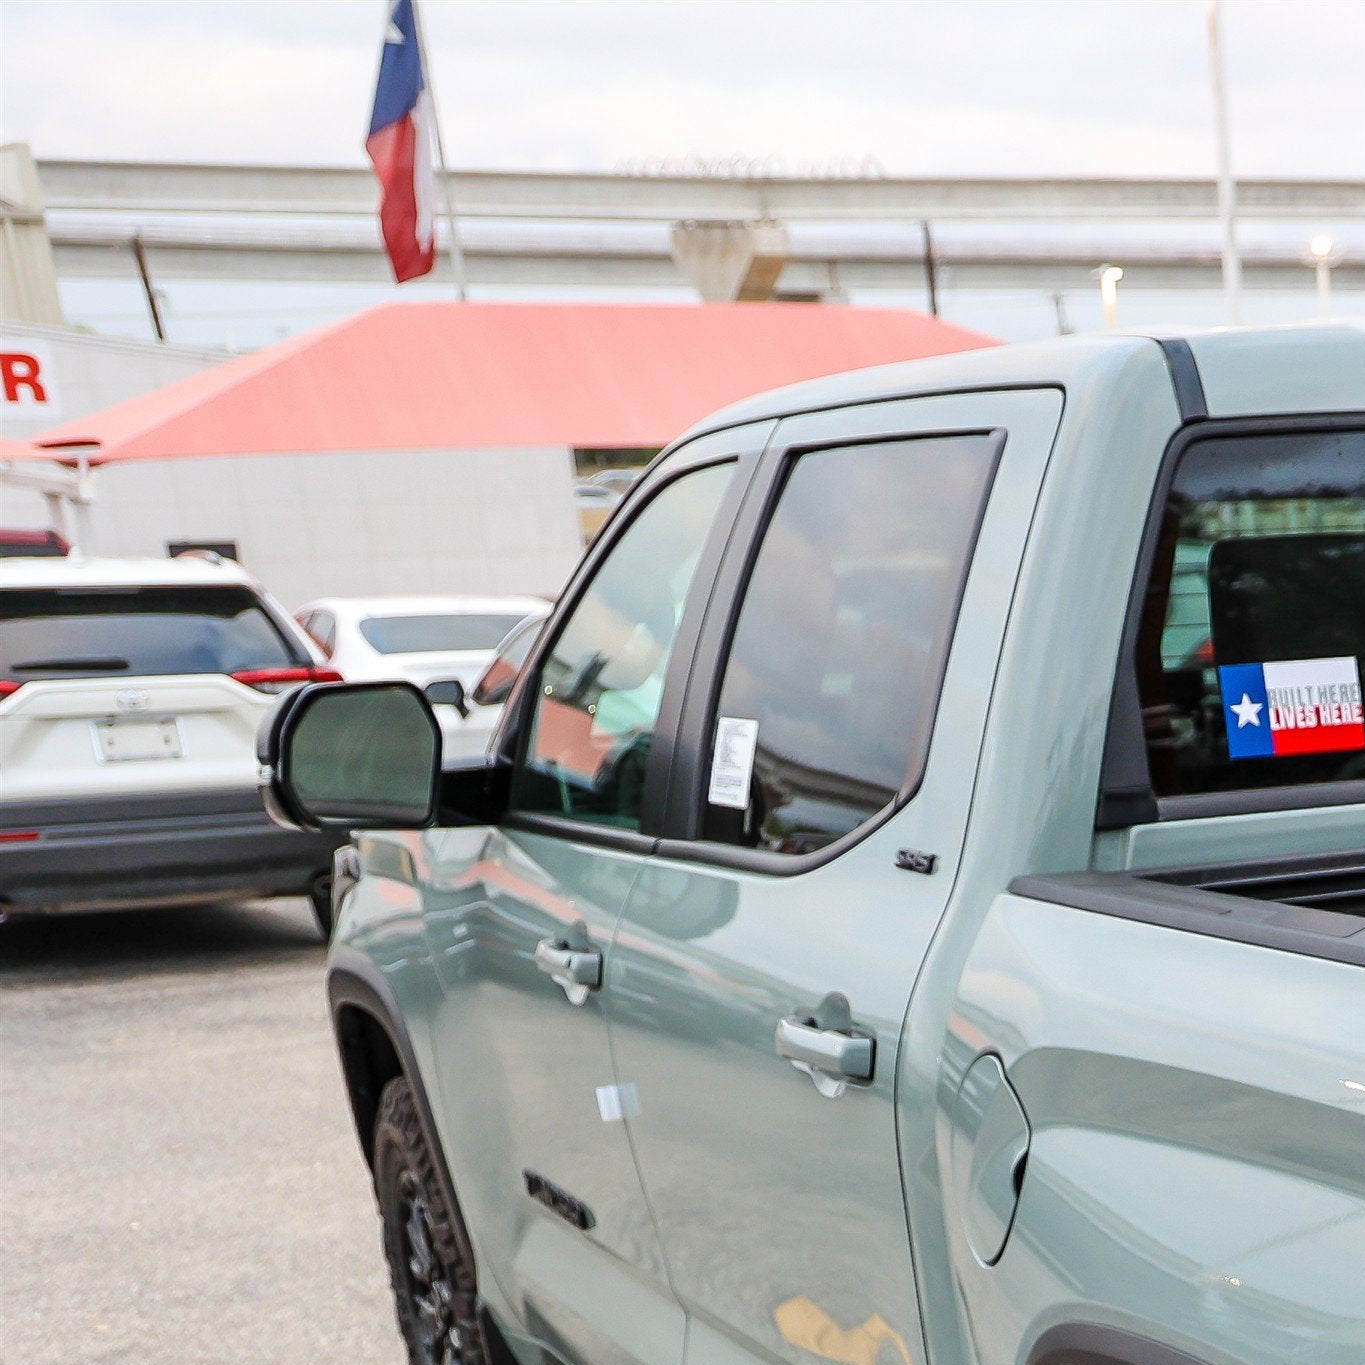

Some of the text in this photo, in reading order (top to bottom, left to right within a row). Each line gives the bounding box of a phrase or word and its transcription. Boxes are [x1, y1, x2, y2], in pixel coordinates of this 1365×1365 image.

[1268, 682, 1362, 708] BUILT HERE
[1269, 704, 1318, 731] LIVES
